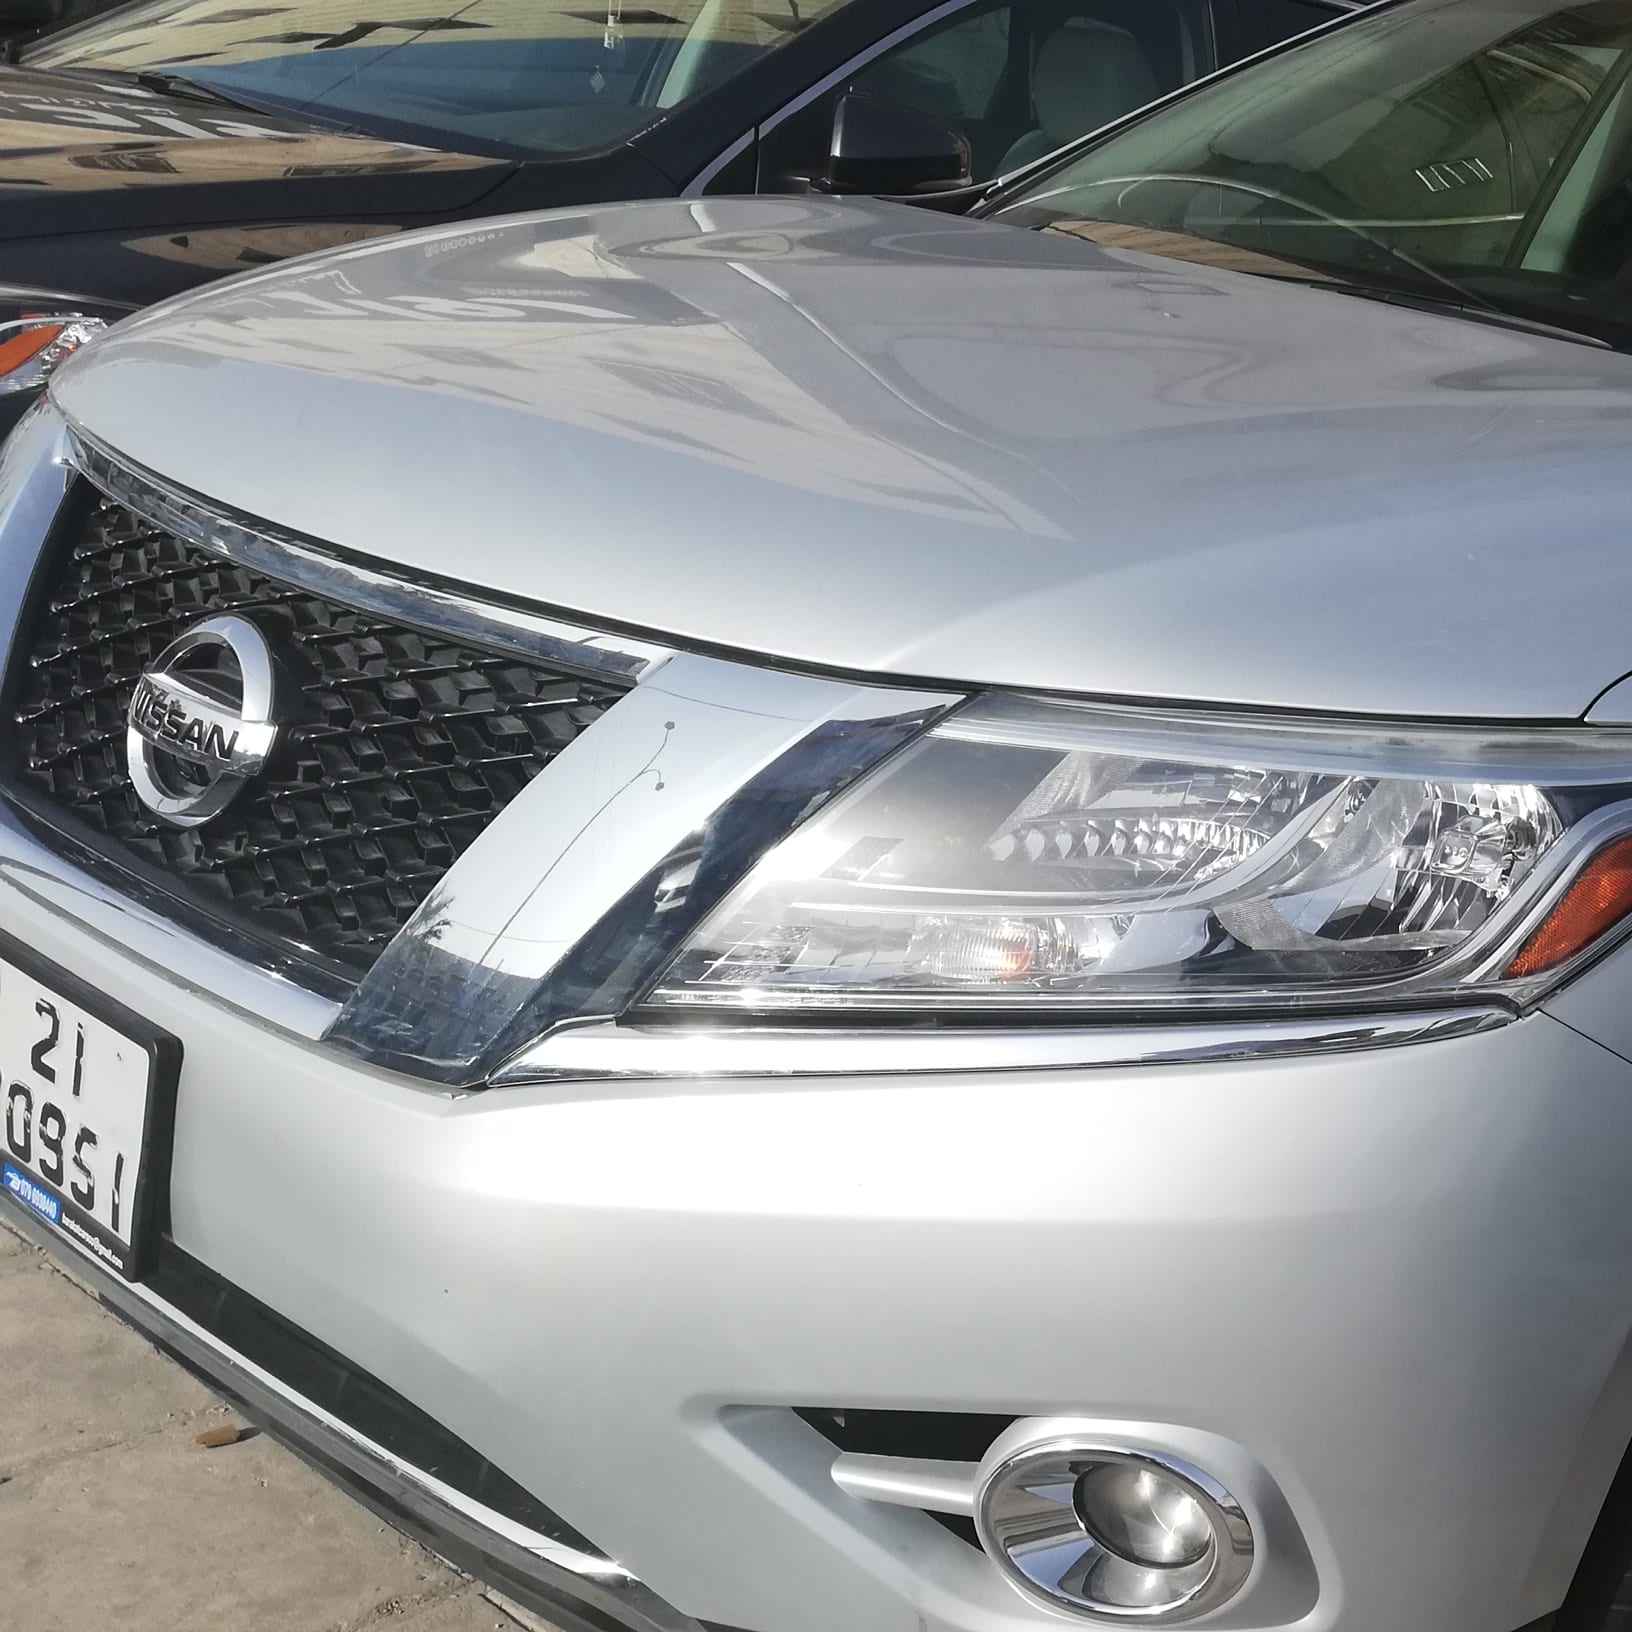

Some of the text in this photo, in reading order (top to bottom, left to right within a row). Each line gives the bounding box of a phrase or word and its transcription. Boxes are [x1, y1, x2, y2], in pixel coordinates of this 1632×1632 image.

[132, 690, 240, 762] NISSAN
[31, 997, 85, 1097] 21
[6, 1081, 125, 1234] 0951
